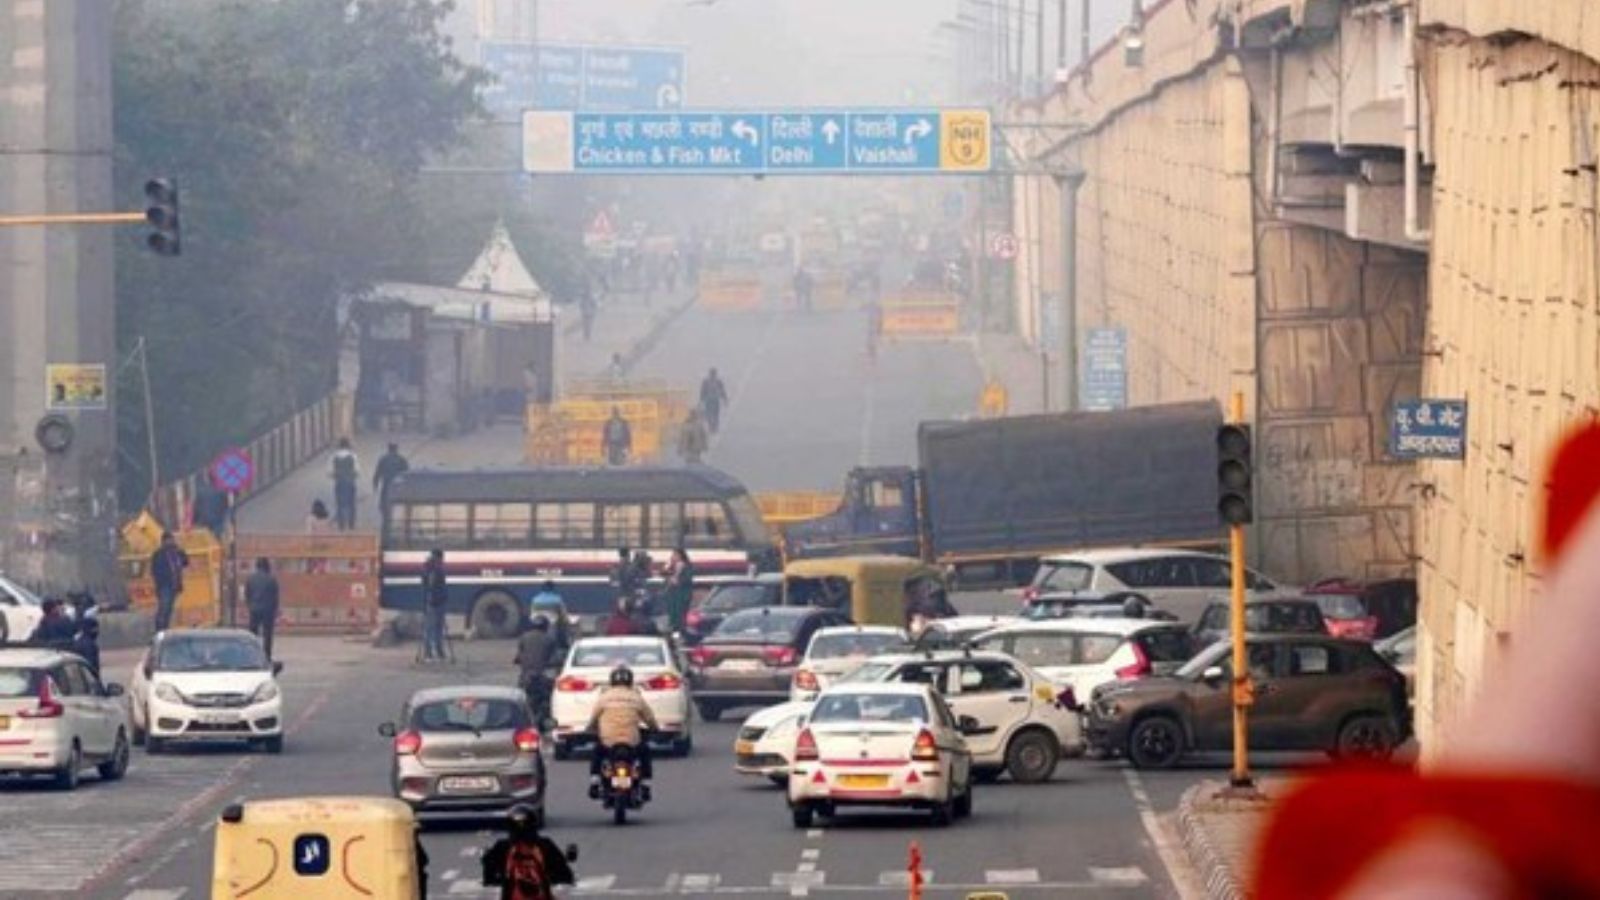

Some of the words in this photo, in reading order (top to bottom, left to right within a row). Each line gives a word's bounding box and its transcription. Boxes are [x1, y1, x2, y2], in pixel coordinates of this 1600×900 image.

[771, 115, 813, 139] दिल्ली
[954, 127, 980, 140] NH
[578, 146, 648, 164] Chicken
[650, 146, 664, 164] &
[669, 146, 705, 164] Fish
[709, 146, 741, 164] Mkt
[771, 145, 814, 163] Delhi
[853, 145, 918, 163] Vaishali
[962, 143, 972, 158] 9
